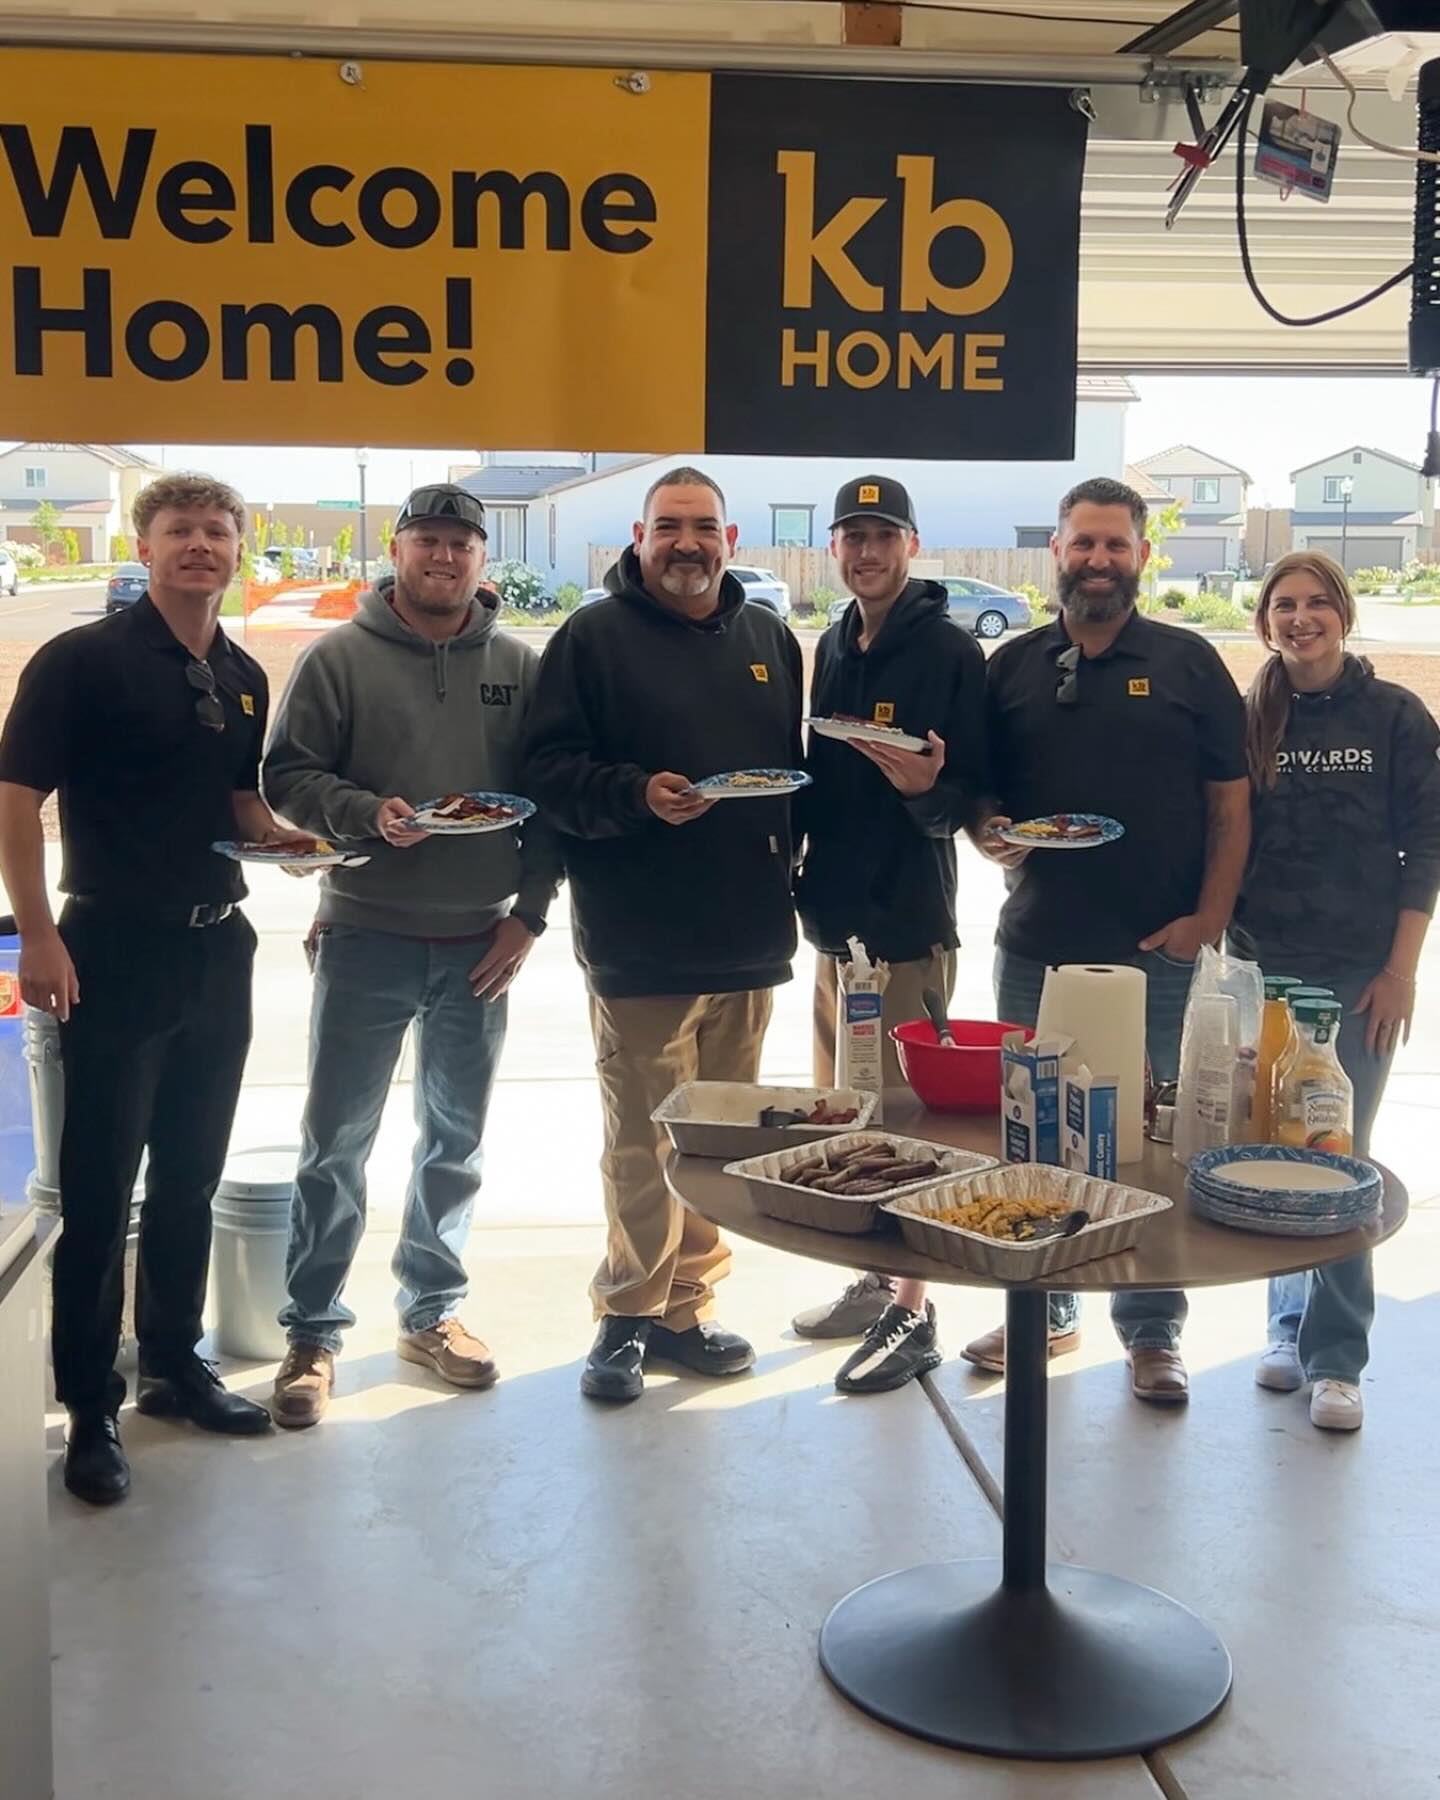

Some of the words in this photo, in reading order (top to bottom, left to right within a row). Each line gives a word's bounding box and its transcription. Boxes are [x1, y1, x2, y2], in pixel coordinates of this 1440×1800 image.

[0, 123, 657, 254] Welcome
[777, 149, 1014, 316] kb
[12, 266, 476, 387] Home!
[781, 328, 1006, 391] HOME
[480, 683, 512, 706] CAT
[1276, 748, 1373, 766] DWARDS
